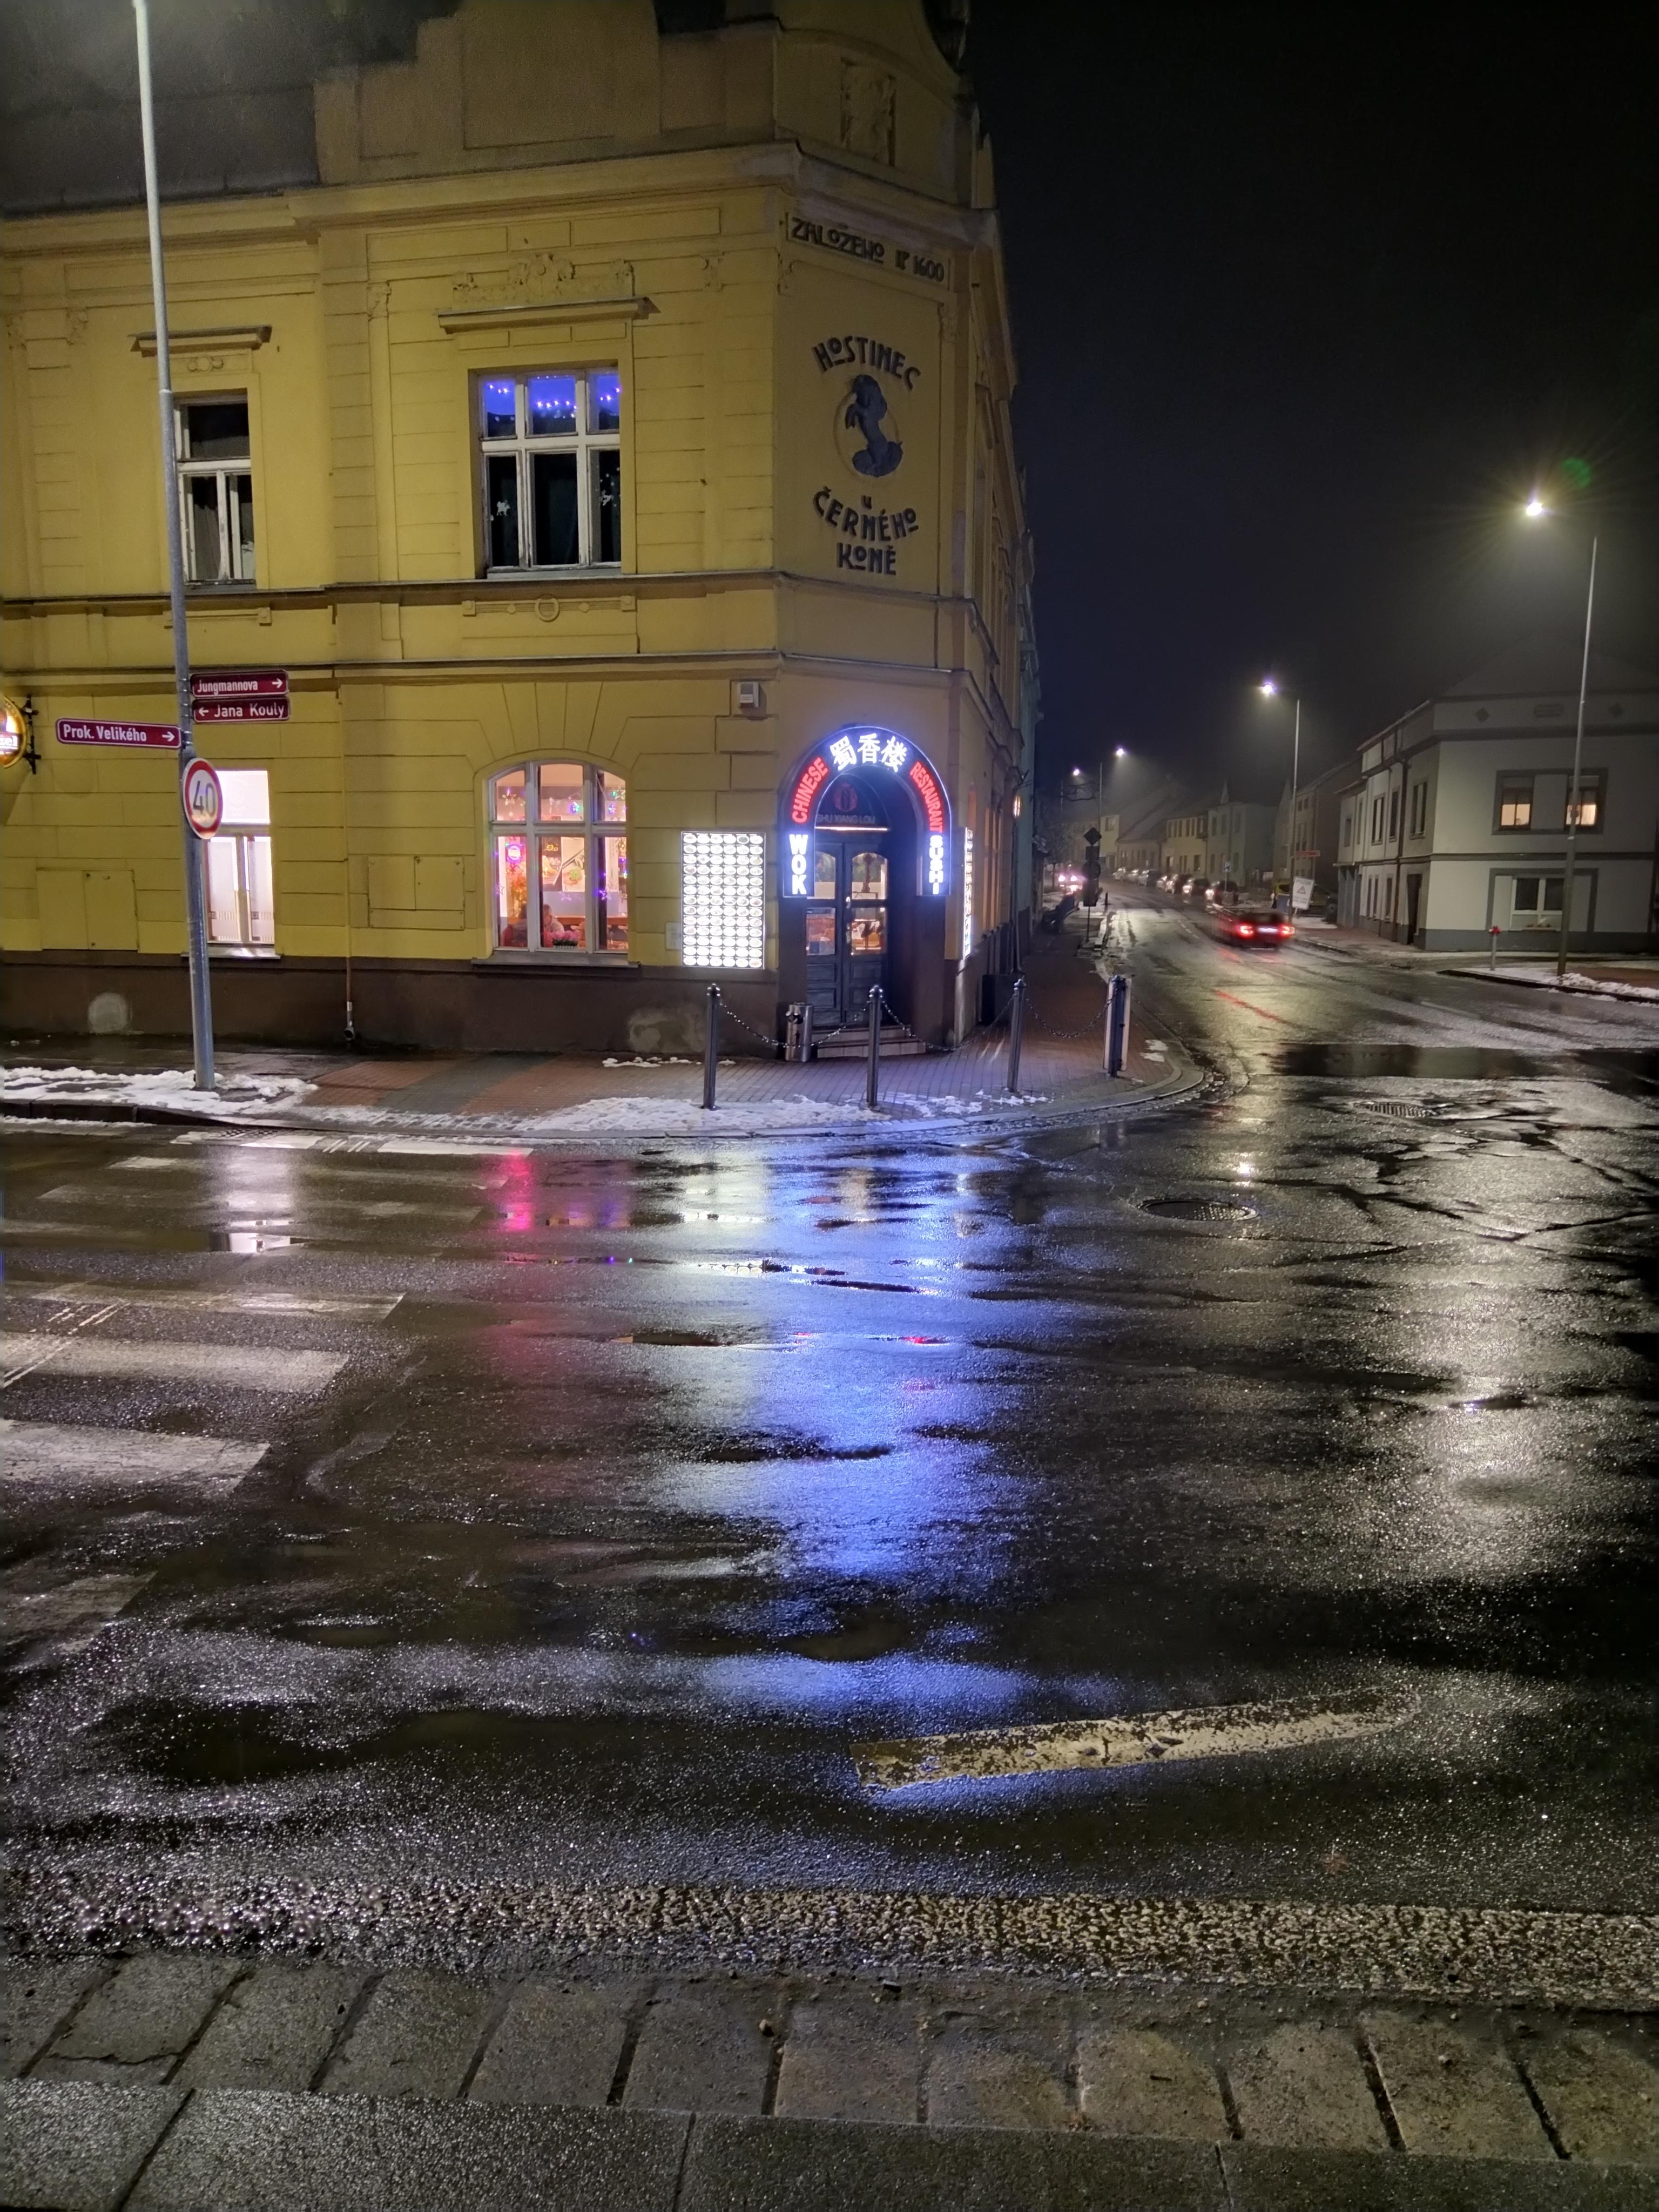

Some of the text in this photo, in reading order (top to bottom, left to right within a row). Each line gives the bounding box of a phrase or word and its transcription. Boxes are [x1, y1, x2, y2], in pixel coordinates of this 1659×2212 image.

[812, 335, 921, 391] HOSTINEC
[813, 486, 919, 542] ČERNÉHO
[837, 542, 896, 575] KONĚ
[197, 680, 258, 695] Jungmannova
[214, 703, 285, 718] Jana Kouly
[63, 724, 147, 741] Prok. Velikého
[830, 733, 907, 773] 蜀香楼
[193, 780, 216, 818] 40
[792, 757, 943, 833] CHINESE RESTAURANT
[834, 814, 858, 823] XIANG
[789, 834, 808, 895] WOK
[929, 834, 944, 895] SUSHI
